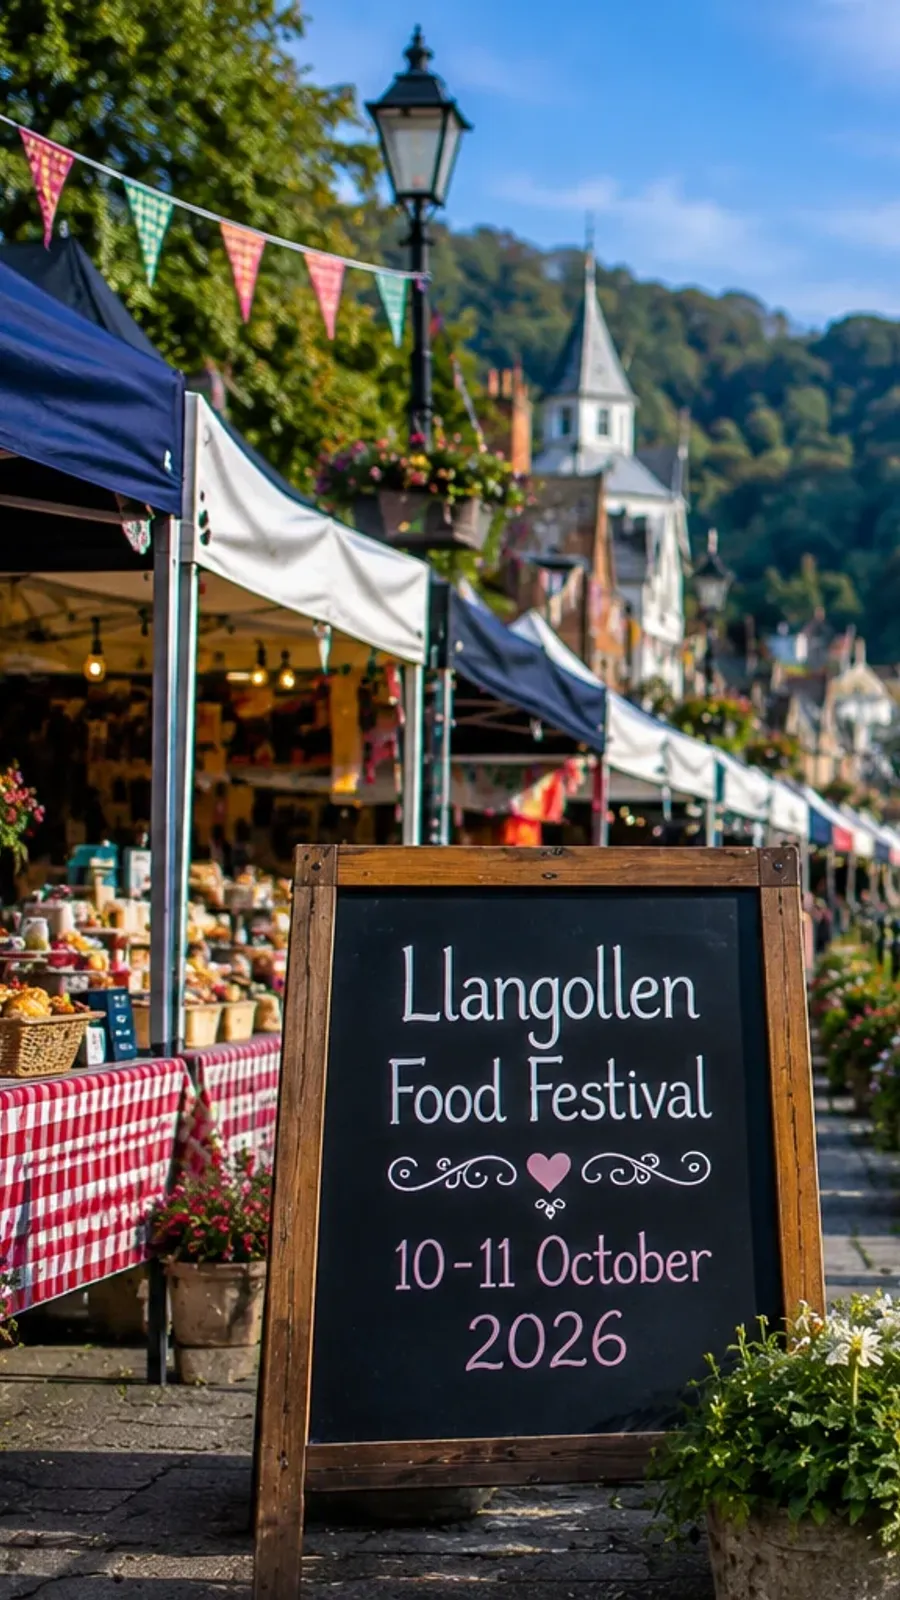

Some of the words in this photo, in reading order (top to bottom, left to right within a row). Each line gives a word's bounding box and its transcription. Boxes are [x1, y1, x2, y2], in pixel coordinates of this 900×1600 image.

[402, 944, 701, 1050] Llangollen
[388, 1057, 507, 1125] Food
[527, 1054, 712, 1122] Festival
[394, 1237, 516, 1291] 10-11
[536, 1230, 713, 1287] October
[465, 1309, 628, 1372] 2026
